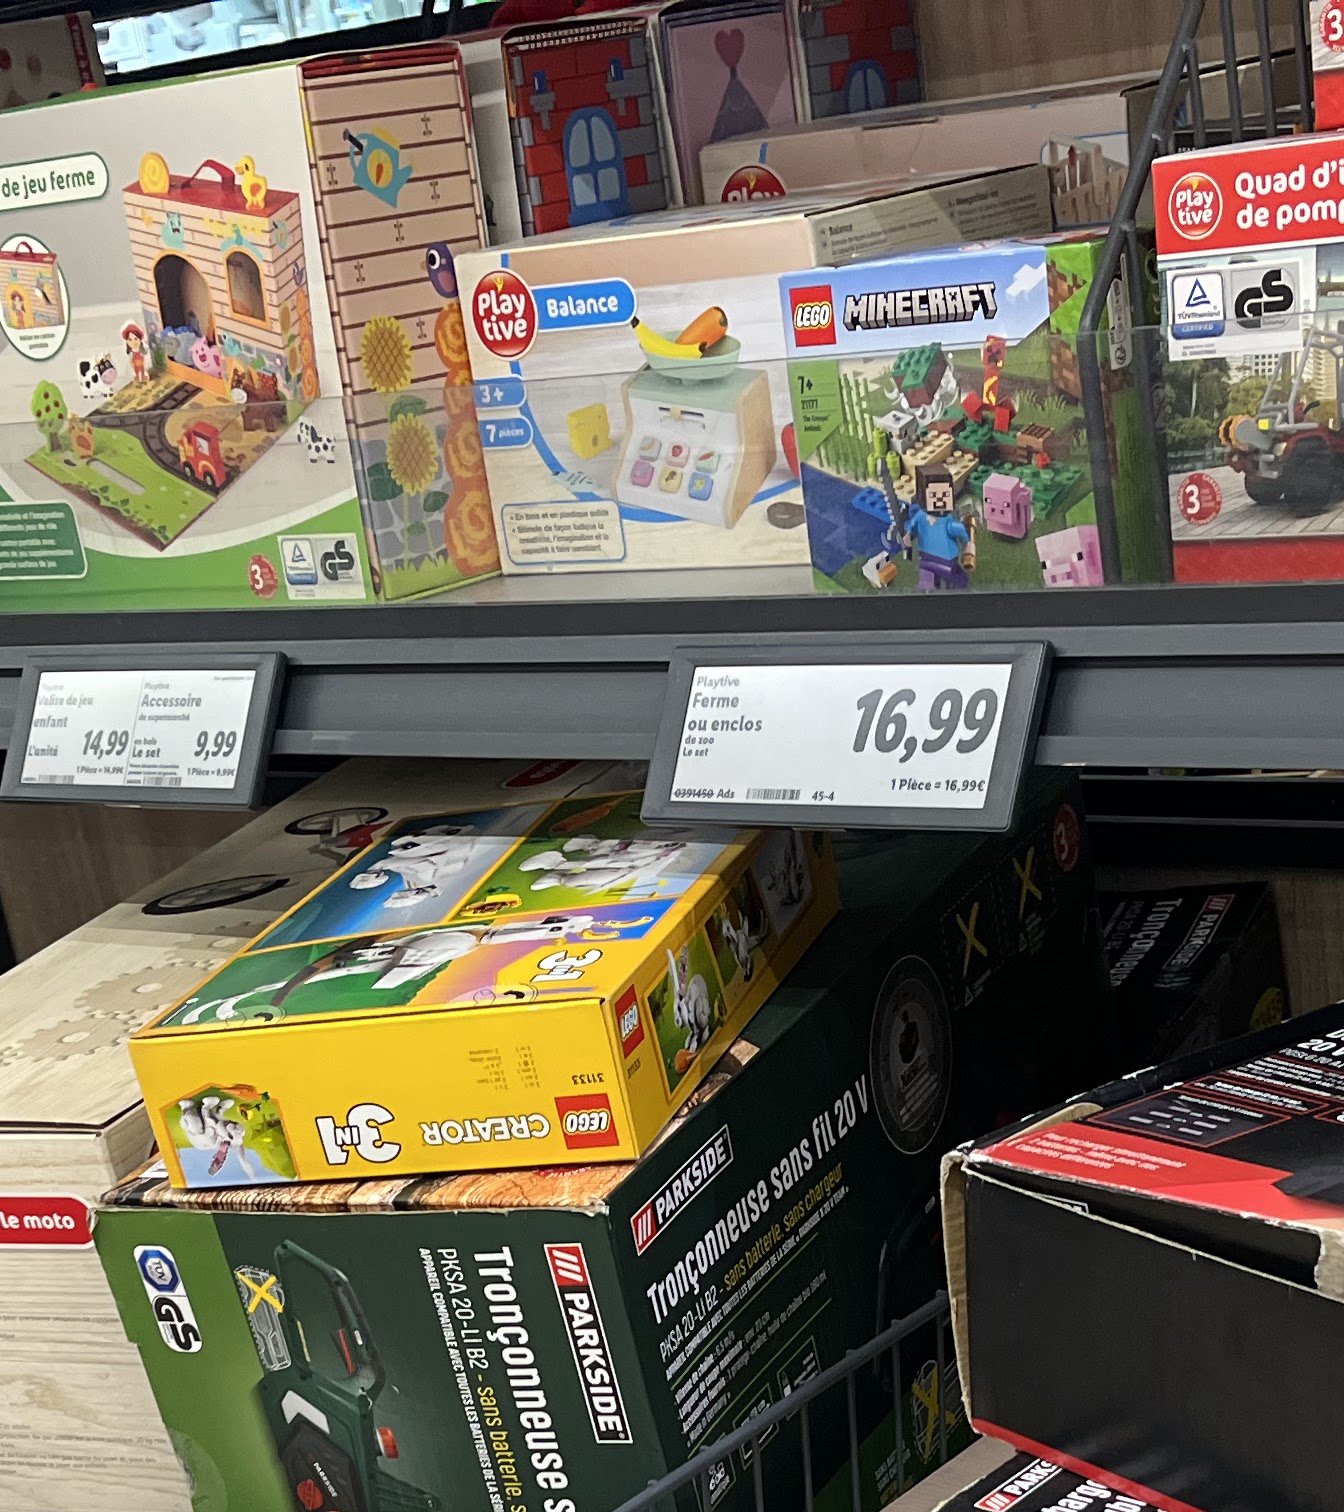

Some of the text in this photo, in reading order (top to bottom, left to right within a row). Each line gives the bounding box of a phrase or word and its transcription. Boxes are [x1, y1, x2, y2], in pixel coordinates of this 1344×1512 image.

[2, 177, 19, 198] de
[23, 175, 46, 199] jeu
[50, 169, 95, 190] ferme
[1235, 164, 1305, 199] Quad
[1236, 203, 1268, 229] de
[478, 290, 525, 316] Play
[547, 295, 618, 317] Balance
[844, 281, 997, 330] MINECRAFT
[483, 315, 527, 341] tive
[696, 675, 740, 689] Playtive
[141, 694, 201, 708] Accessoire
[692, 692, 739, 708] Ferme
[688, 716, 762, 732] ou enclos
[853, 688, 998, 763] 16,99
[194, 730, 237, 761] 9,99
[420, 1113, 550, 1146] CREATOR
[655, 1140, 726, 1224] PARKSIDE
[646, 1074, 868, 1324] Tronçonneuse sans fil 20 V
[23, 1214, 75, 1231] moto
[565, 1292, 623, 1434] PARKSIDE
